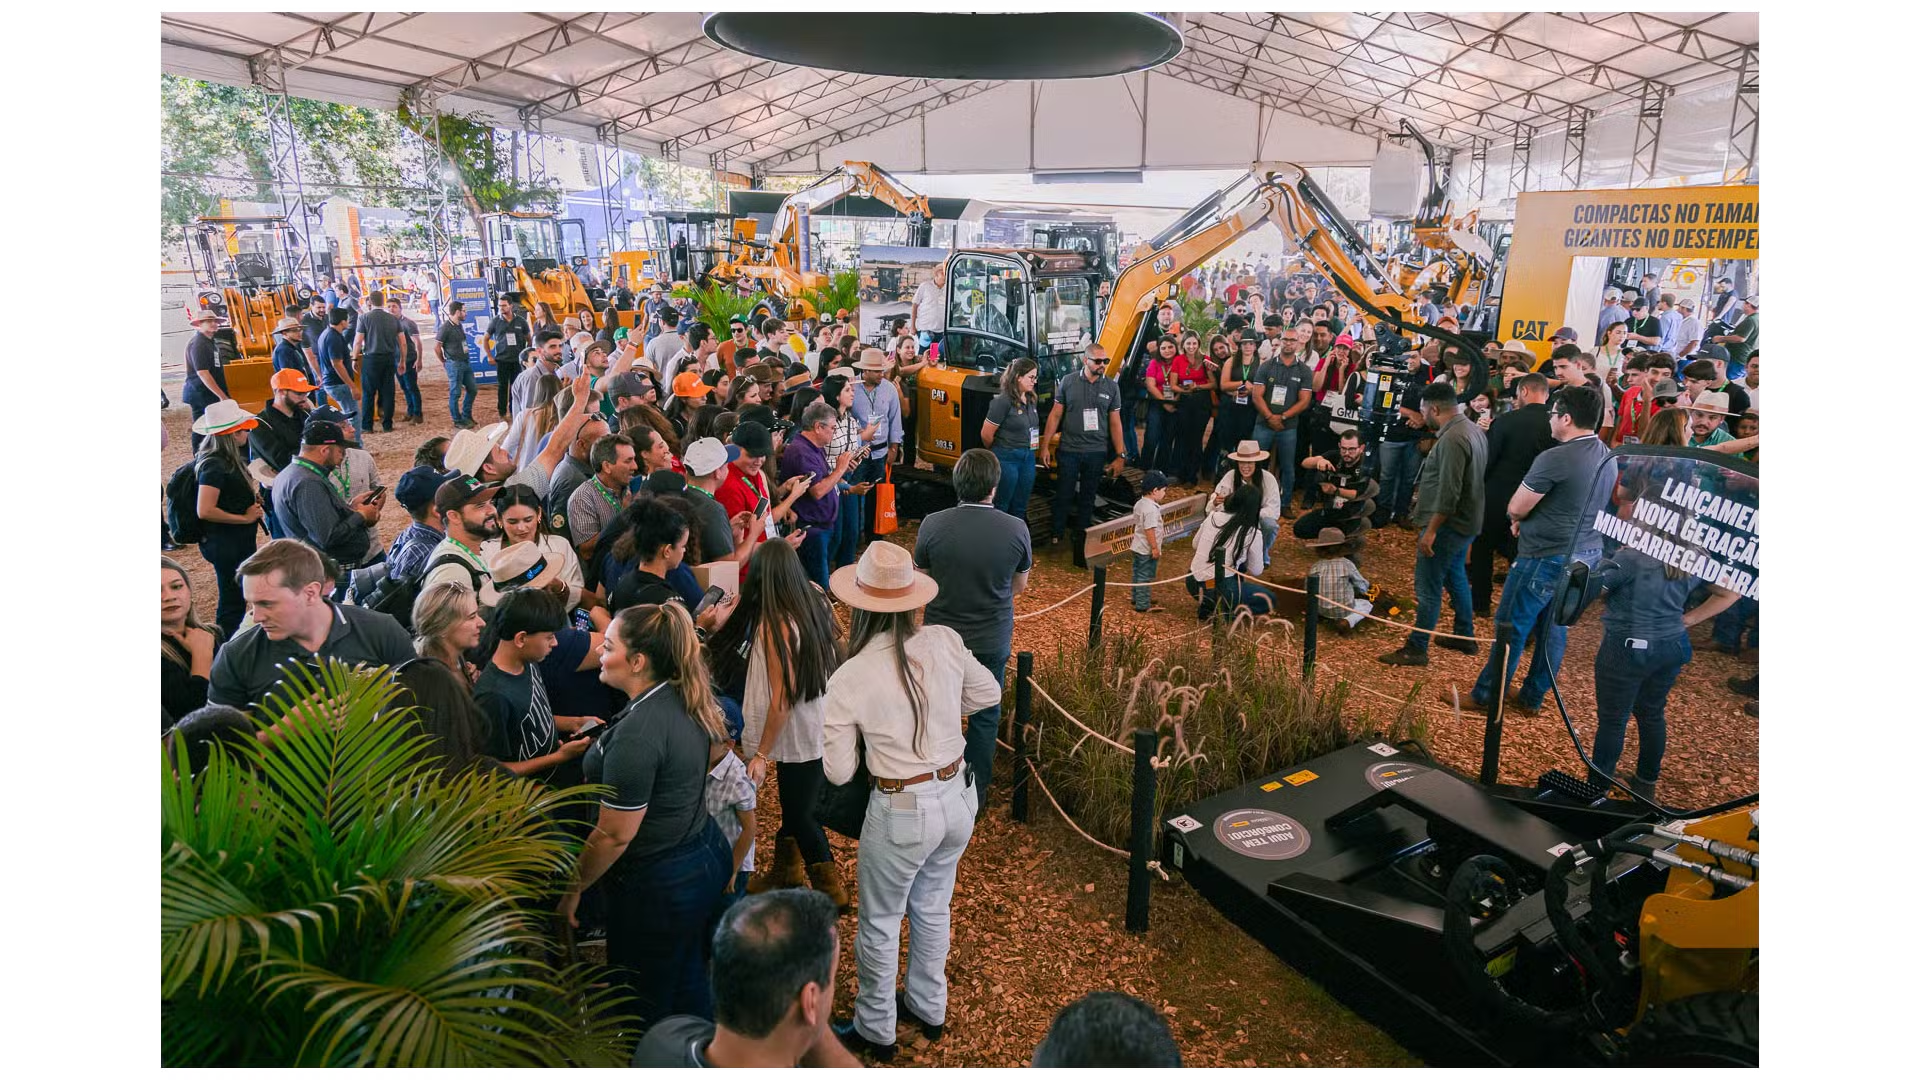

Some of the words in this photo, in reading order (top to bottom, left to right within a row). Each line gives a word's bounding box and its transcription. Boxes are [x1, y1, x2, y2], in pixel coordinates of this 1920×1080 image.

[1573, 203, 1670, 224] COMPACTAS
[1674, 203, 1700, 224] NO
[1564, 228, 1641, 249] GIGANTES
[1644, 228, 1670, 249] NO
[1672, 228, 1759, 250] DESEMPE
[1153, 255, 1171, 275] CAT
[1512, 319, 1549, 342] CAT
[931, 388, 946, 404] CAT
[1632, 497, 1682, 536] NOVA
[1593, 509, 1759, 602] MINICARREGADEIRA
[1228, 822, 1293, 841] CONSÓRCIO!
[1268, 832, 1295, 844] AQUI
[1242, 837, 1270, 848] TEM
